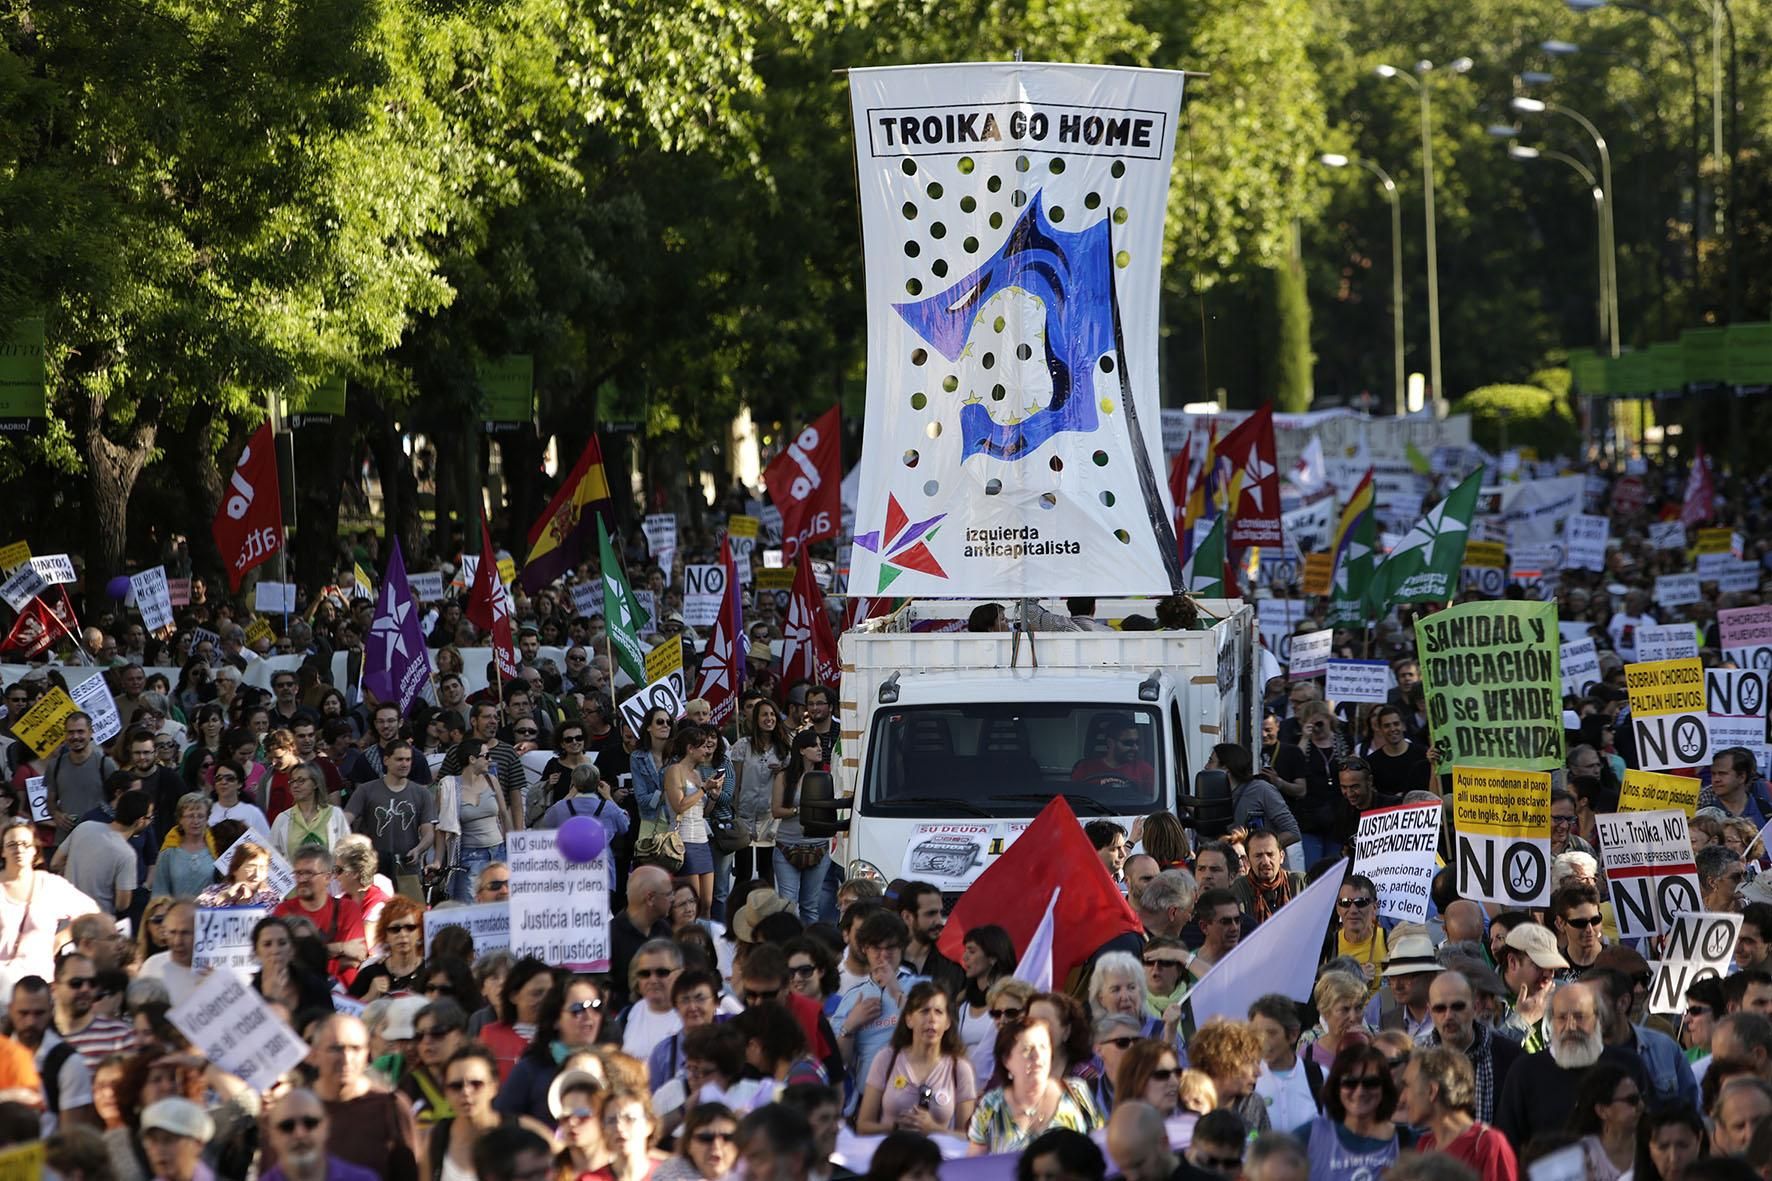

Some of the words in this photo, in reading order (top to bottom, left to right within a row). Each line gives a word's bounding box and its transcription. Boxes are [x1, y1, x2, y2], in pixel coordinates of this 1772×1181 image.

[879, 113, 1003, 146] TROIKA
[1009, 111, 1049, 141] GO
[1059, 114, 1154, 148] HOME
[966, 526, 1040, 543] izquierda
[963, 540, 1081, 559] anticapitalista
[686, 568, 724, 594] NO
[1424, 615, 1524, 653] SANIDAD
[1426, 644, 1552, 689] EDUCACIÓN
[1628, 670, 1659, 688] SOBRAN
[1631, 694, 1663, 713] FALTAN
[1707, 671, 1763, 715] NO
[622, 684, 678, 737] NO
[1452, 697, 1479, 722] se
[1636, 715, 1708, 767] NO
[1457, 773, 1473, 787] Aquí
[1474, 777, 1487, 787] nos
[1488, 776, 1522, 790] condenan
[1522, 778, 1529, 788] al
[1470, 794, 1488, 804] usan
[1489, 794, 1515, 808] trabajo
[1656, 788, 1669, 801] con
[1359, 812, 1400, 838] JUSTICIA
[1401, 808, 1439, 832] EFICAZ,
[1458, 806, 1477, 819] Corte
[1502, 810, 1520, 823] Zara,
[1626, 820, 1665, 846] Troika,
[1663, 816, 1686, 841] NO!
[511, 837, 526, 852] NO
[1356, 833, 1436, 861] INDEPENDIENTE.
[511, 858, 561, 873] sindicatos,
[1459, 835, 1547, 902] NO
[1606, 855, 1613, 865] IT
[1613, 853, 1631, 865] DOES
[1631, 851, 1644, 863] NOT
[1643, 850, 1679, 863] REPRESENT
[1367, 864, 1425, 879] subvencionar
[1425, 868, 1432, 878] a
[511, 877, 565, 896] patronales
[567, 880, 574, 895] y
[576, 878, 606, 892] clero.
[1389, 880, 1428, 900] partidos,
[1389, 899, 1397, 912] y
[1397, 898, 1425, 916] clero.
[1611, 875, 1700, 934] NO
[520, 908, 568, 930] Justicia
[571, 908, 606, 931] lenta,
[548, 938, 607, 965] injusticia!
[1665, 918, 1736, 962] NO
